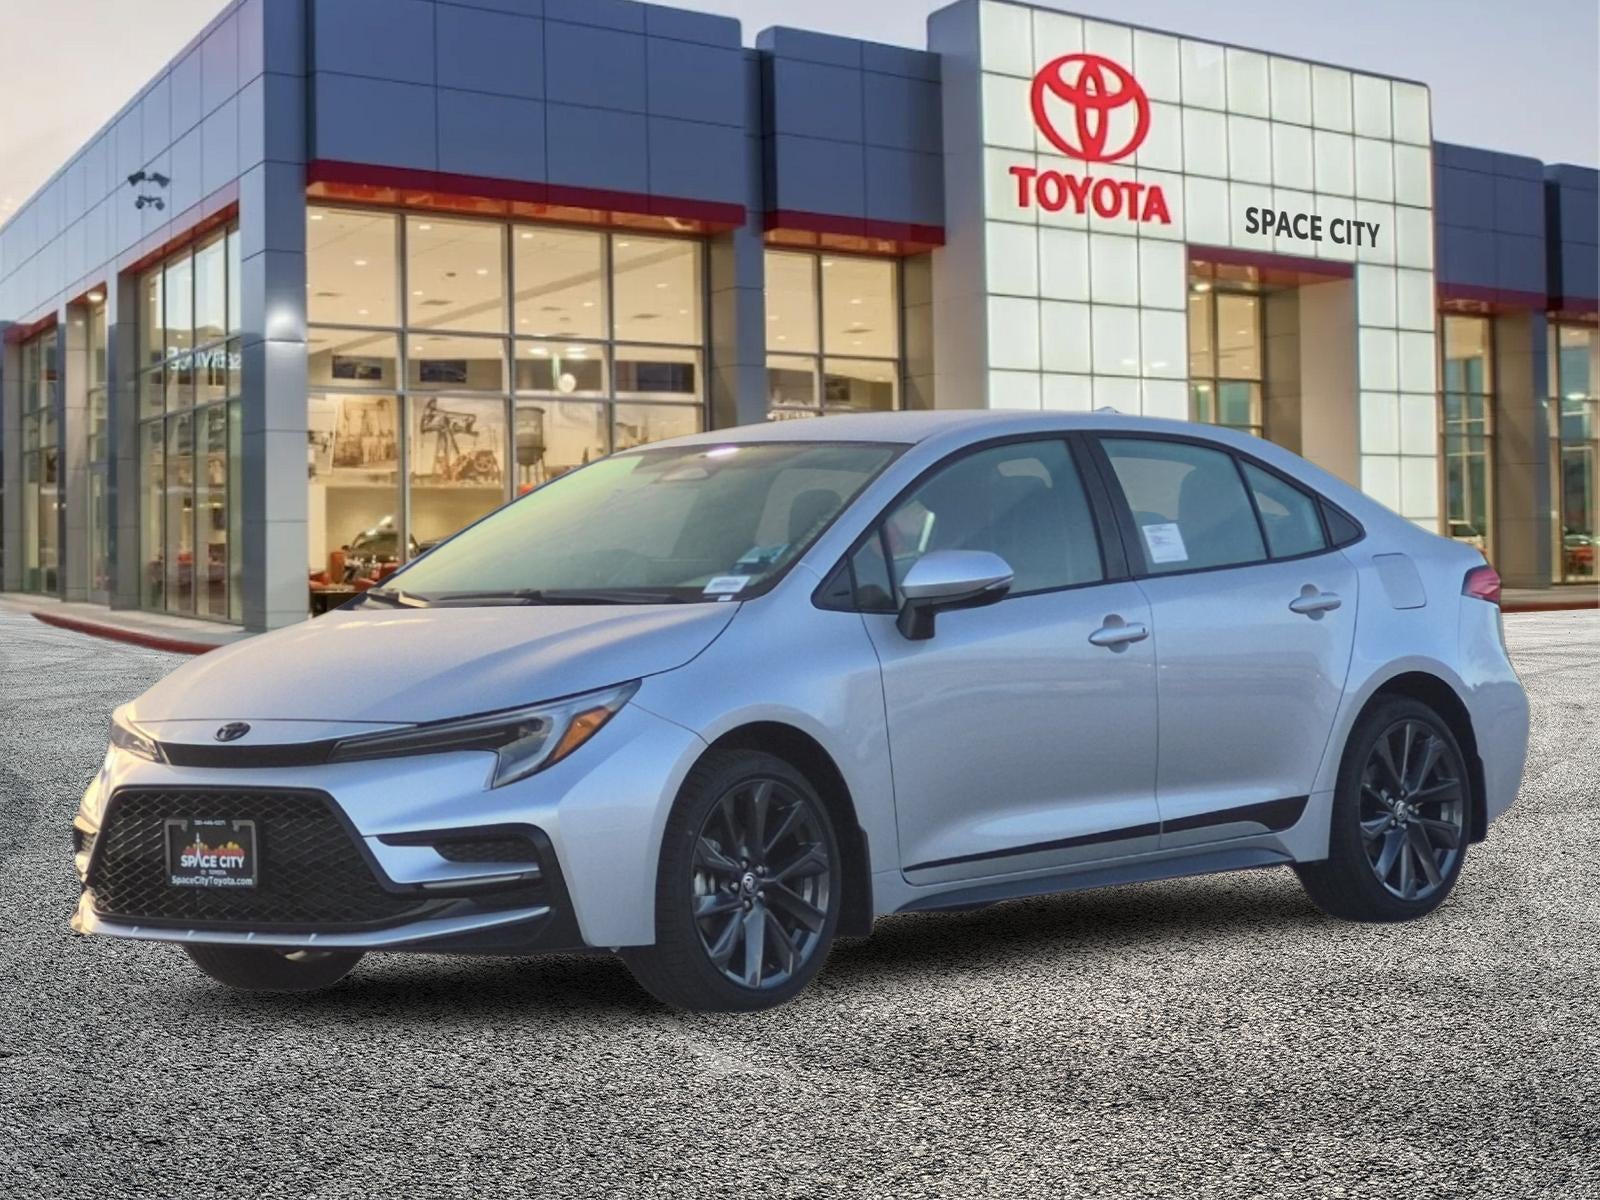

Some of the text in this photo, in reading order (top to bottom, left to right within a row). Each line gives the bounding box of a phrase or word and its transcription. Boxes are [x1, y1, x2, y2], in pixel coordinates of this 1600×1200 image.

[1009, 166, 1171, 225] TOYOTA
[1245, 206, 1381, 248] SPACE CITY
[181, 855, 244, 868] SPACE CITY
[172, 875, 252, 886] SpaceCityToyota.com
